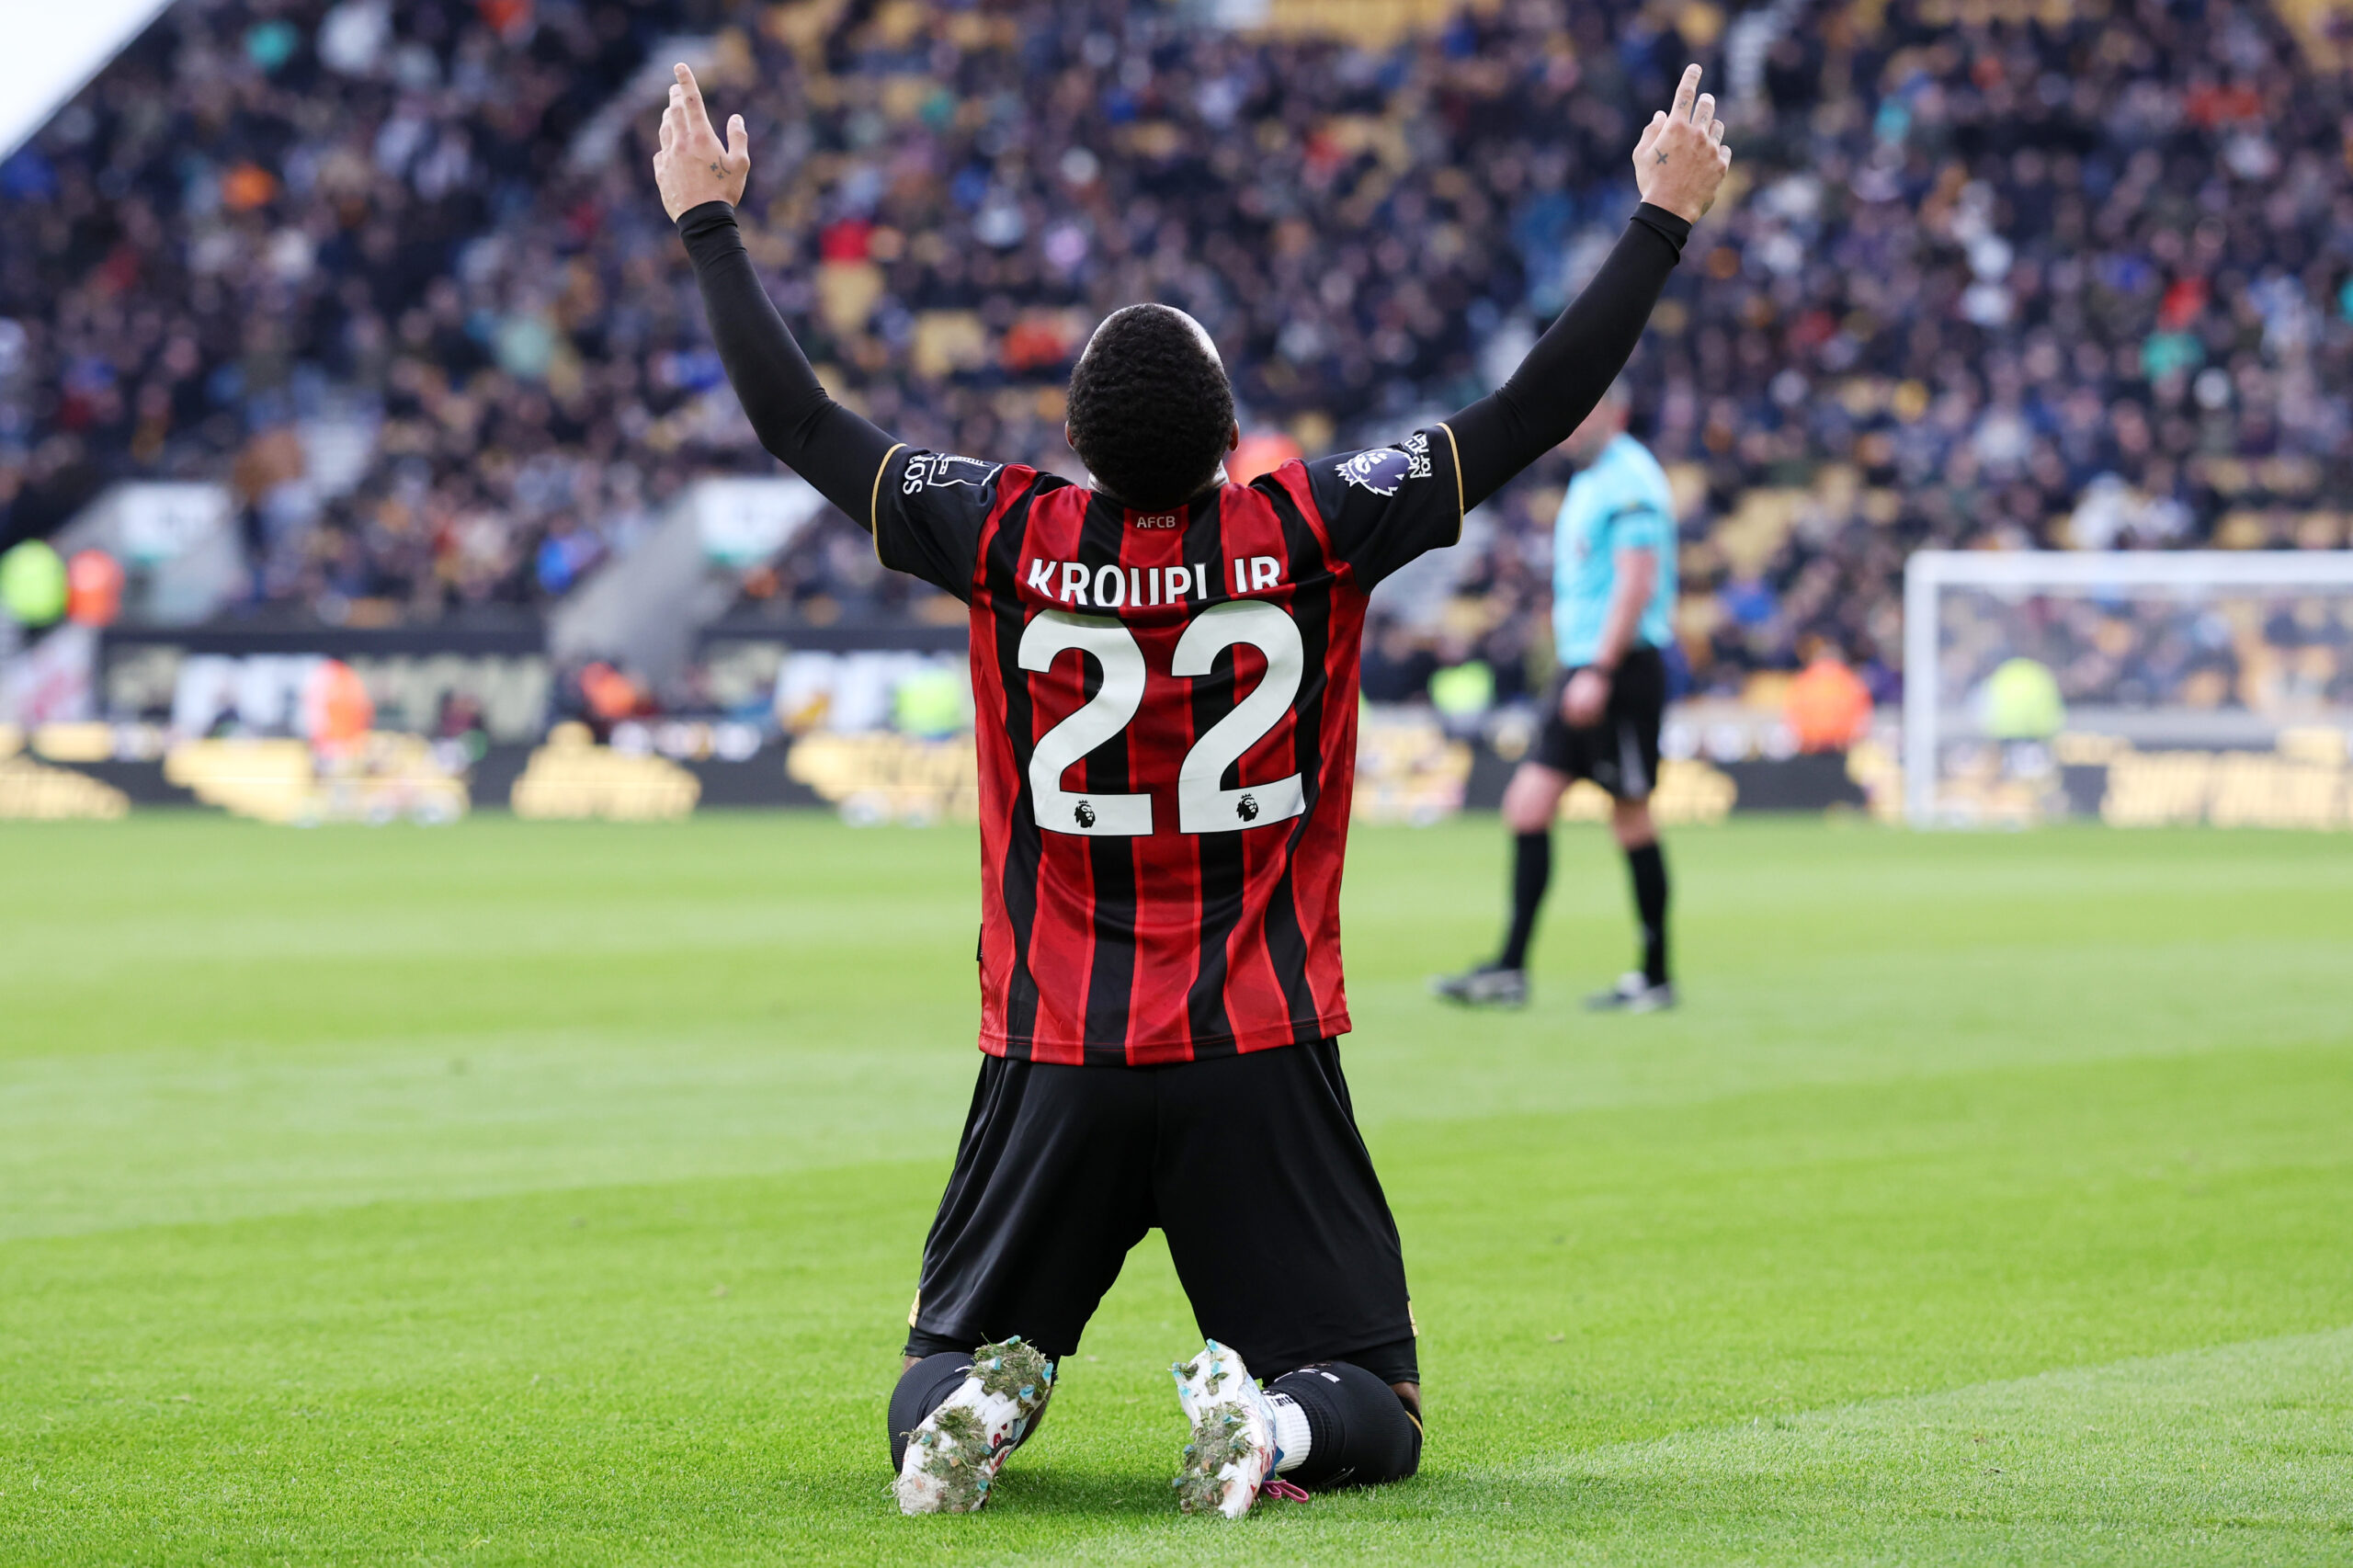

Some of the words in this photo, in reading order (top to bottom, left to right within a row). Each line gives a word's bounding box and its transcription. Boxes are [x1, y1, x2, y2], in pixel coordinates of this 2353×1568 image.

[1136, 516, 1176, 528] AFCB
[1027, 558, 1208, 608] KROUPI
[1017, 599, 1306, 836] 22
